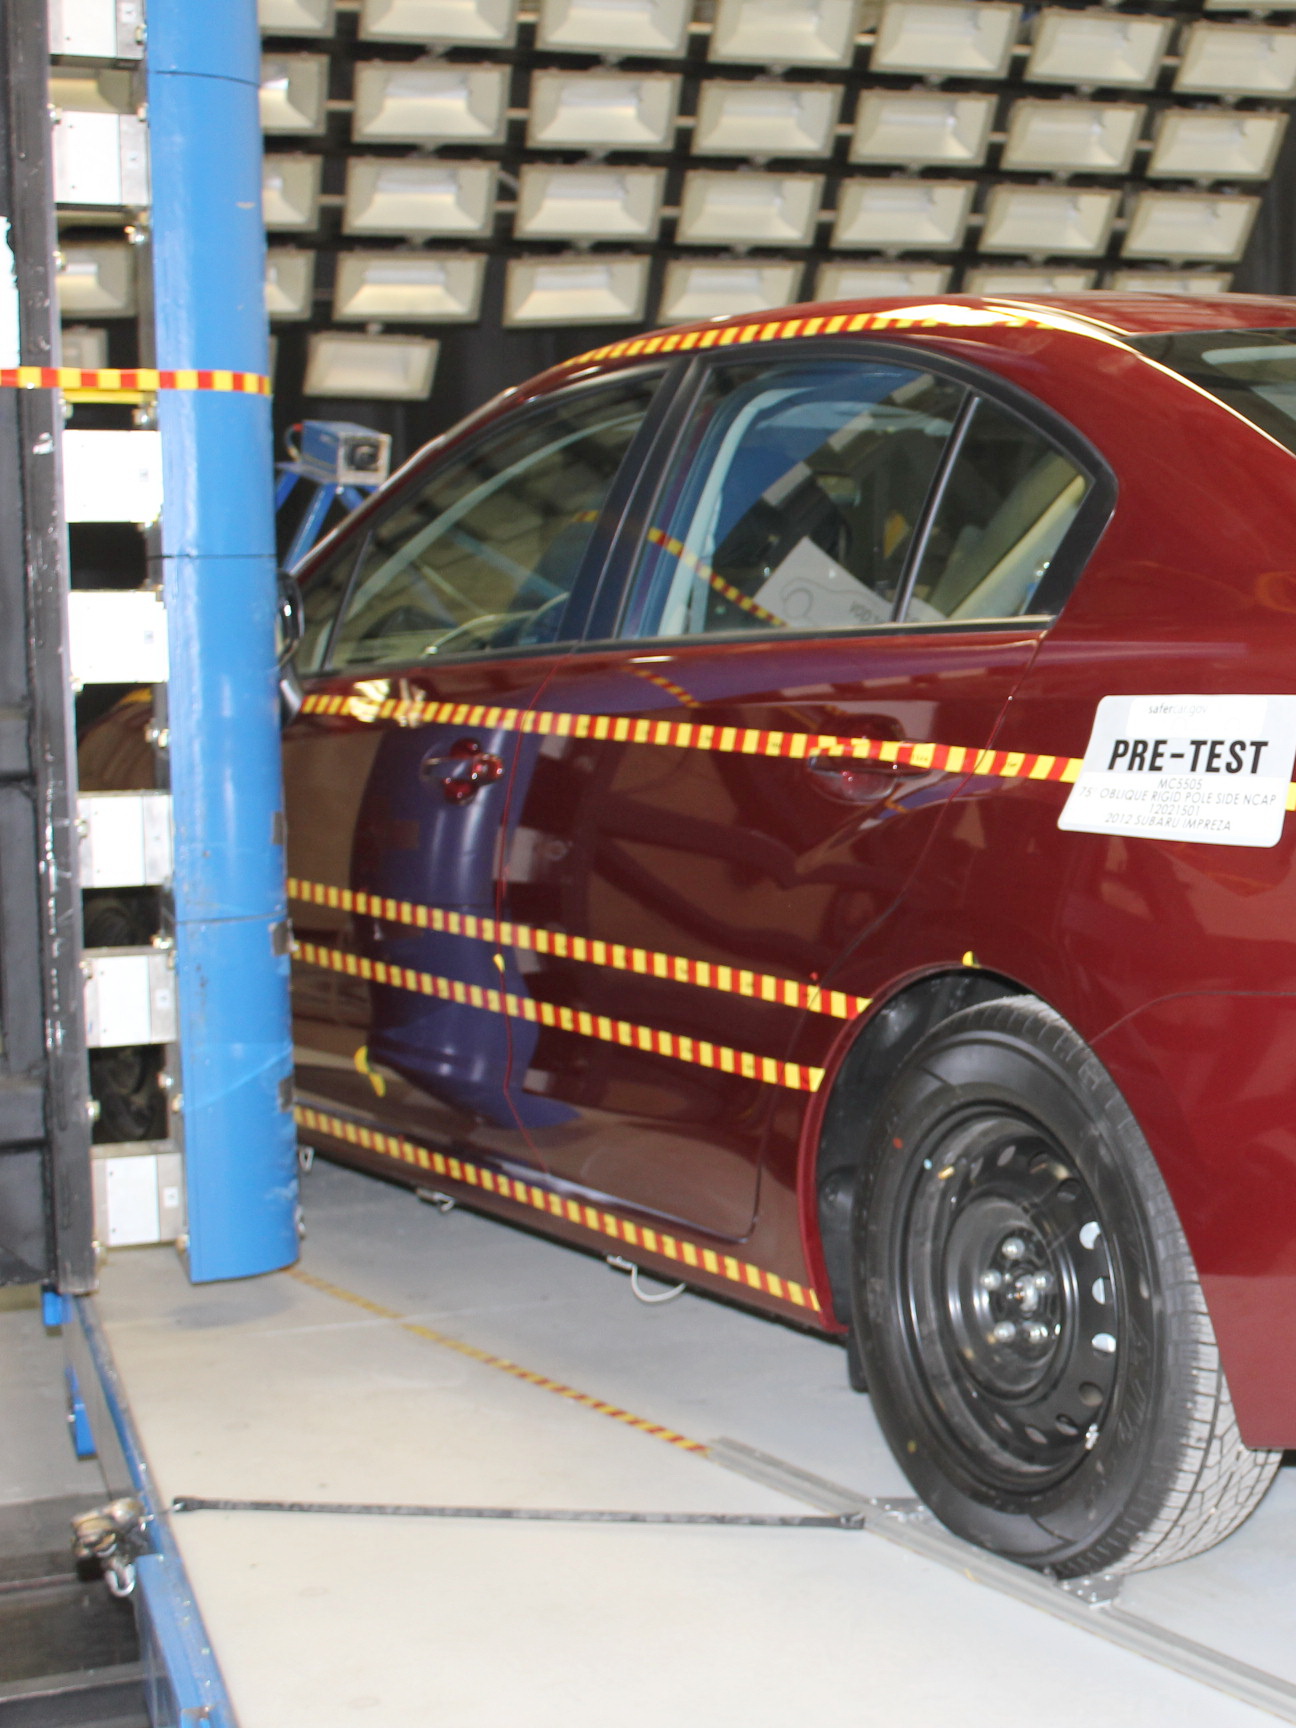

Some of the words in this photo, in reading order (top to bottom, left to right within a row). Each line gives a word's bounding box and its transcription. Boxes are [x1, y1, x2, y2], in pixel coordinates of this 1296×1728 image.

[1148, 702, 1209, 717] safercar.gov
[1107, 739, 1269, 774] PRE-TEST
[1157, 777, 1203, 791] MC5505
[1099, 787, 1149, 803] OBLIQUE
[1151, 790, 1182, 804] RIGID
[1184, 791, 1213, 806] POLE
[1215, 792, 1240, 806] SIDE
[1242, 792, 1277, 807] NCAP
[1149, 803, 1201, 817] 12021501
[1104, 812, 1133, 826] 2012
[1134, 814, 1181, 829] SUBARU
[1183, 817, 1232, 832] IMPREZA
